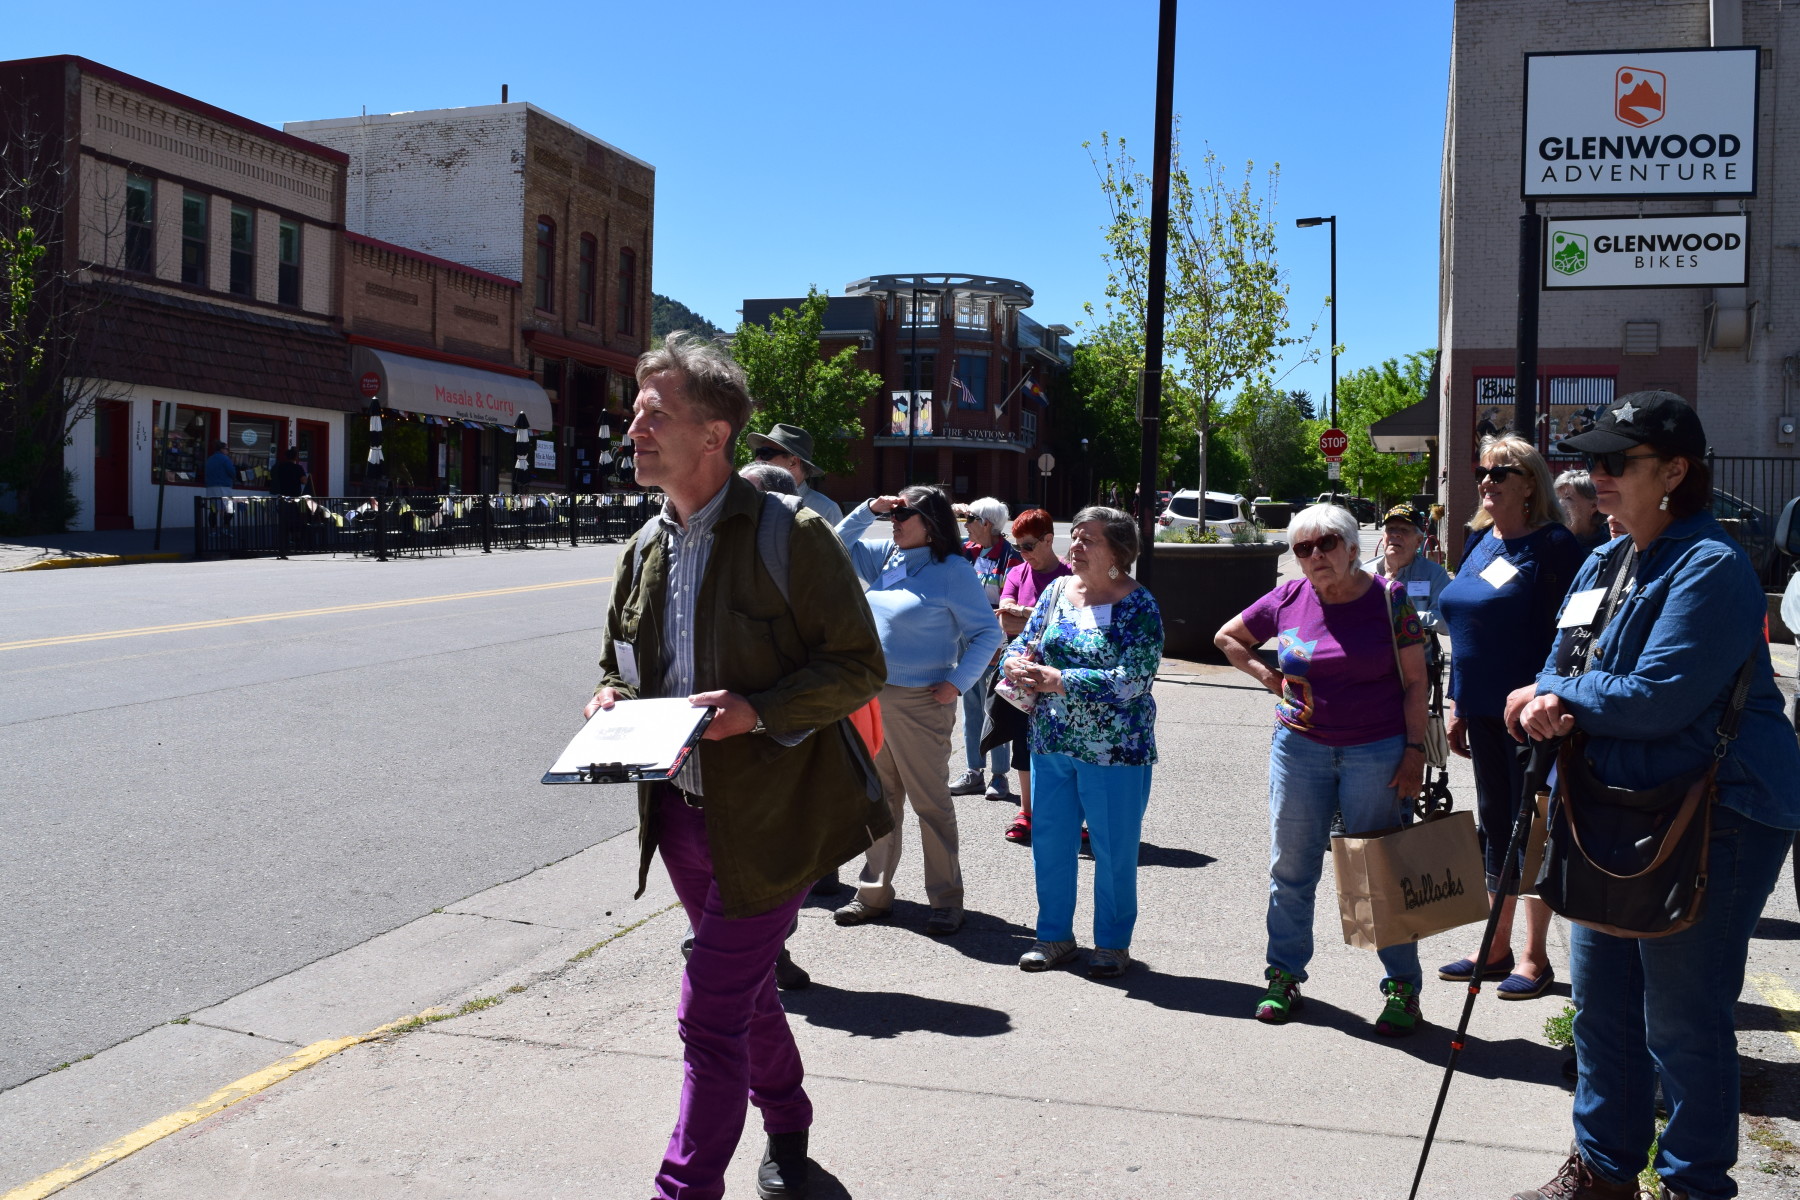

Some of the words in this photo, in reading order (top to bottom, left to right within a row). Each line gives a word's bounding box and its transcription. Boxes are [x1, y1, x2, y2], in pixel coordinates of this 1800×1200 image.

[1538, 133, 1741, 161] GLENWOOD
[1541, 163, 1737, 182] ADVENTURE
[1593, 232, 1741, 254] GLENWOOD
[1635, 254, 1698, 268] BIKES
[434, 384, 473, 407] Masala
[475, 391, 484, 409] &
[486, 393, 514, 416] Curry
[942, 427, 963, 437] FIRE
[968, 429, 1004, 439] STATION
[1321, 437, 1346, 448] STOP
[1400, 868, 1465, 911] Bullocks
